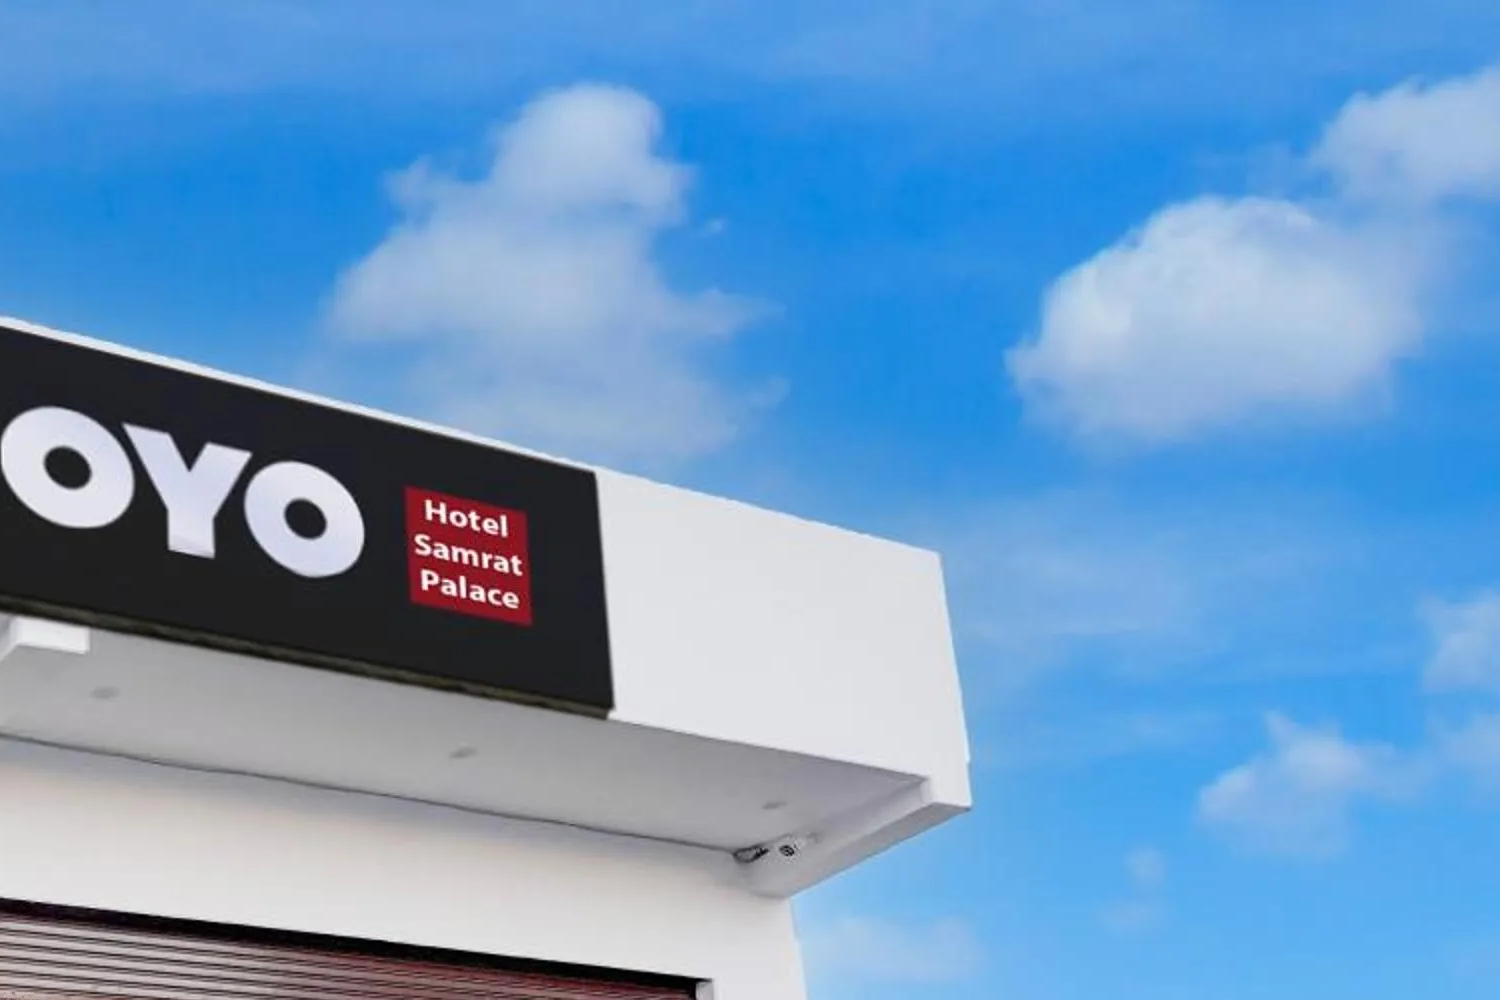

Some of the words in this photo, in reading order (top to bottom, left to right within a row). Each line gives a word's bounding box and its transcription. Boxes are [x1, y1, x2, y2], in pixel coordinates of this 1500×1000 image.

[0, 405, 366, 578] OYO
[424, 499, 508, 538] Hotel
[414, 533, 523, 577] Samrat
[420, 568, 520, 609] Palace
